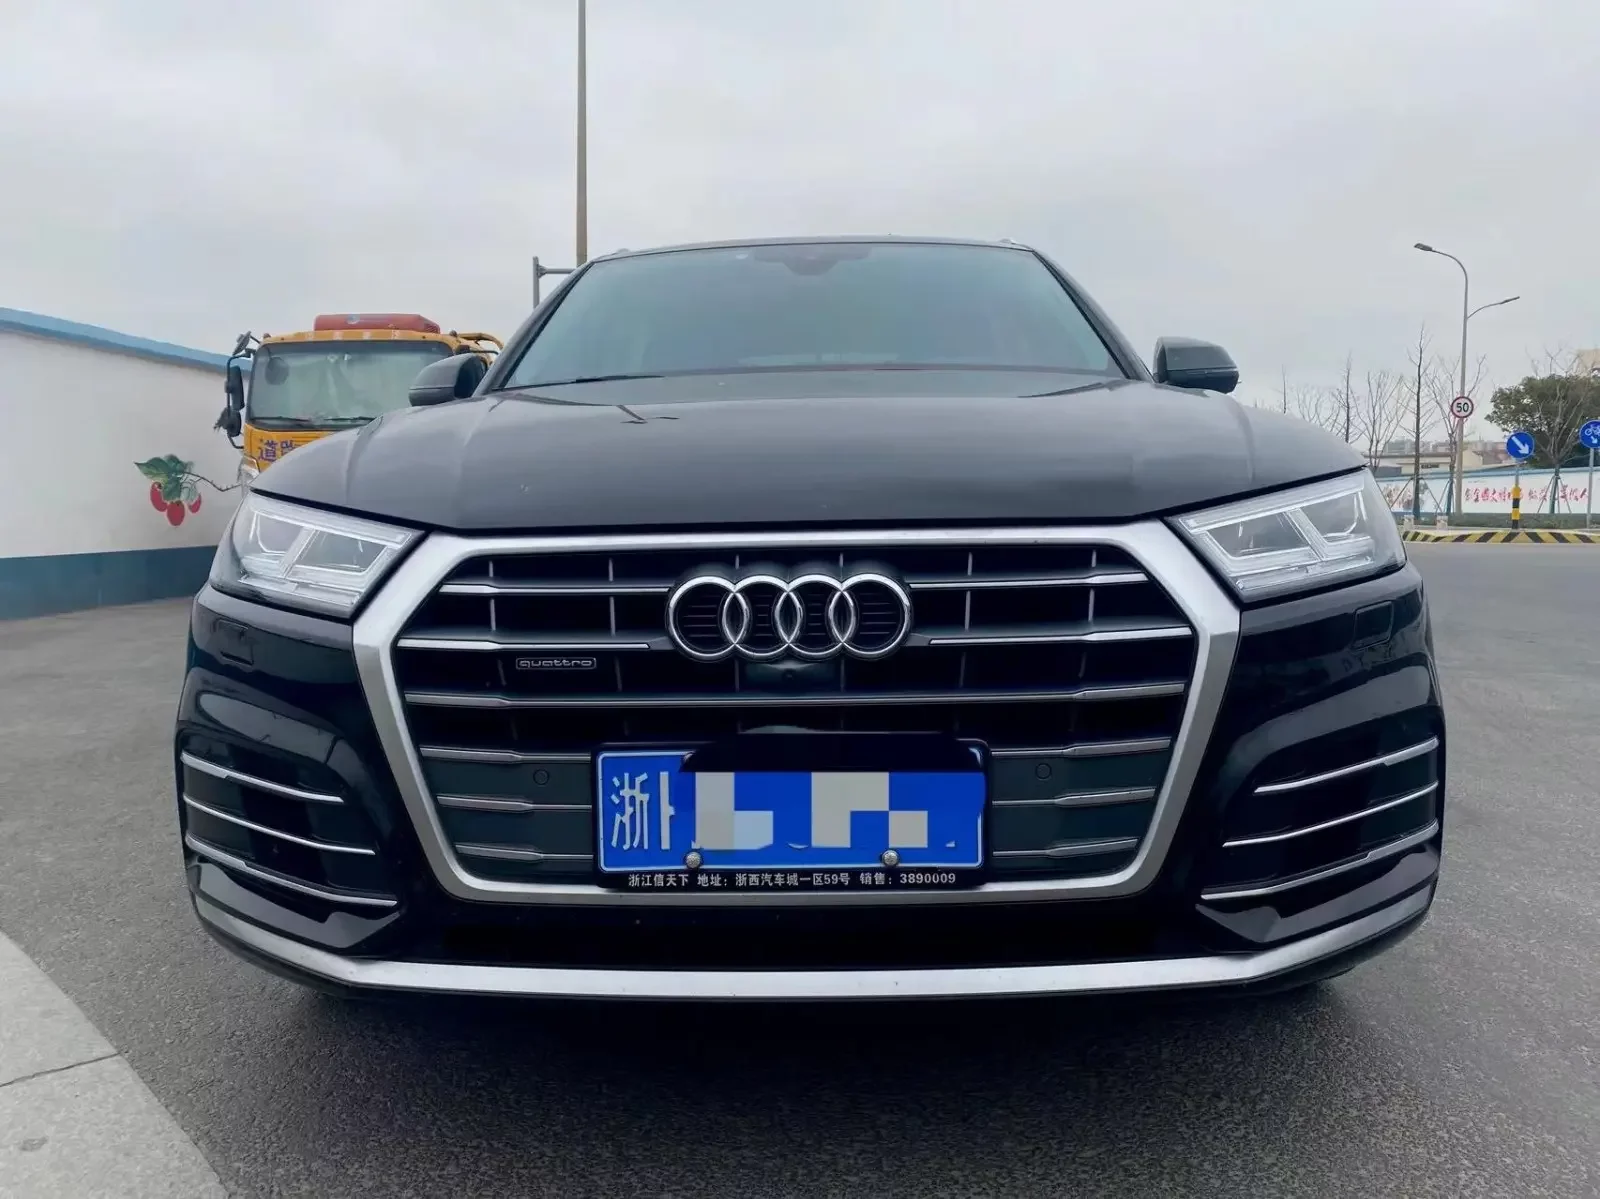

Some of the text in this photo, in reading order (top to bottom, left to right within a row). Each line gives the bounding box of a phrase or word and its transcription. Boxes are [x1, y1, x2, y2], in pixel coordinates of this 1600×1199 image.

[1456, 402, 1470, 413] 50
[519, 659, 592, 668] quattro
[628, 873, 689, 887] 浙江信天下
